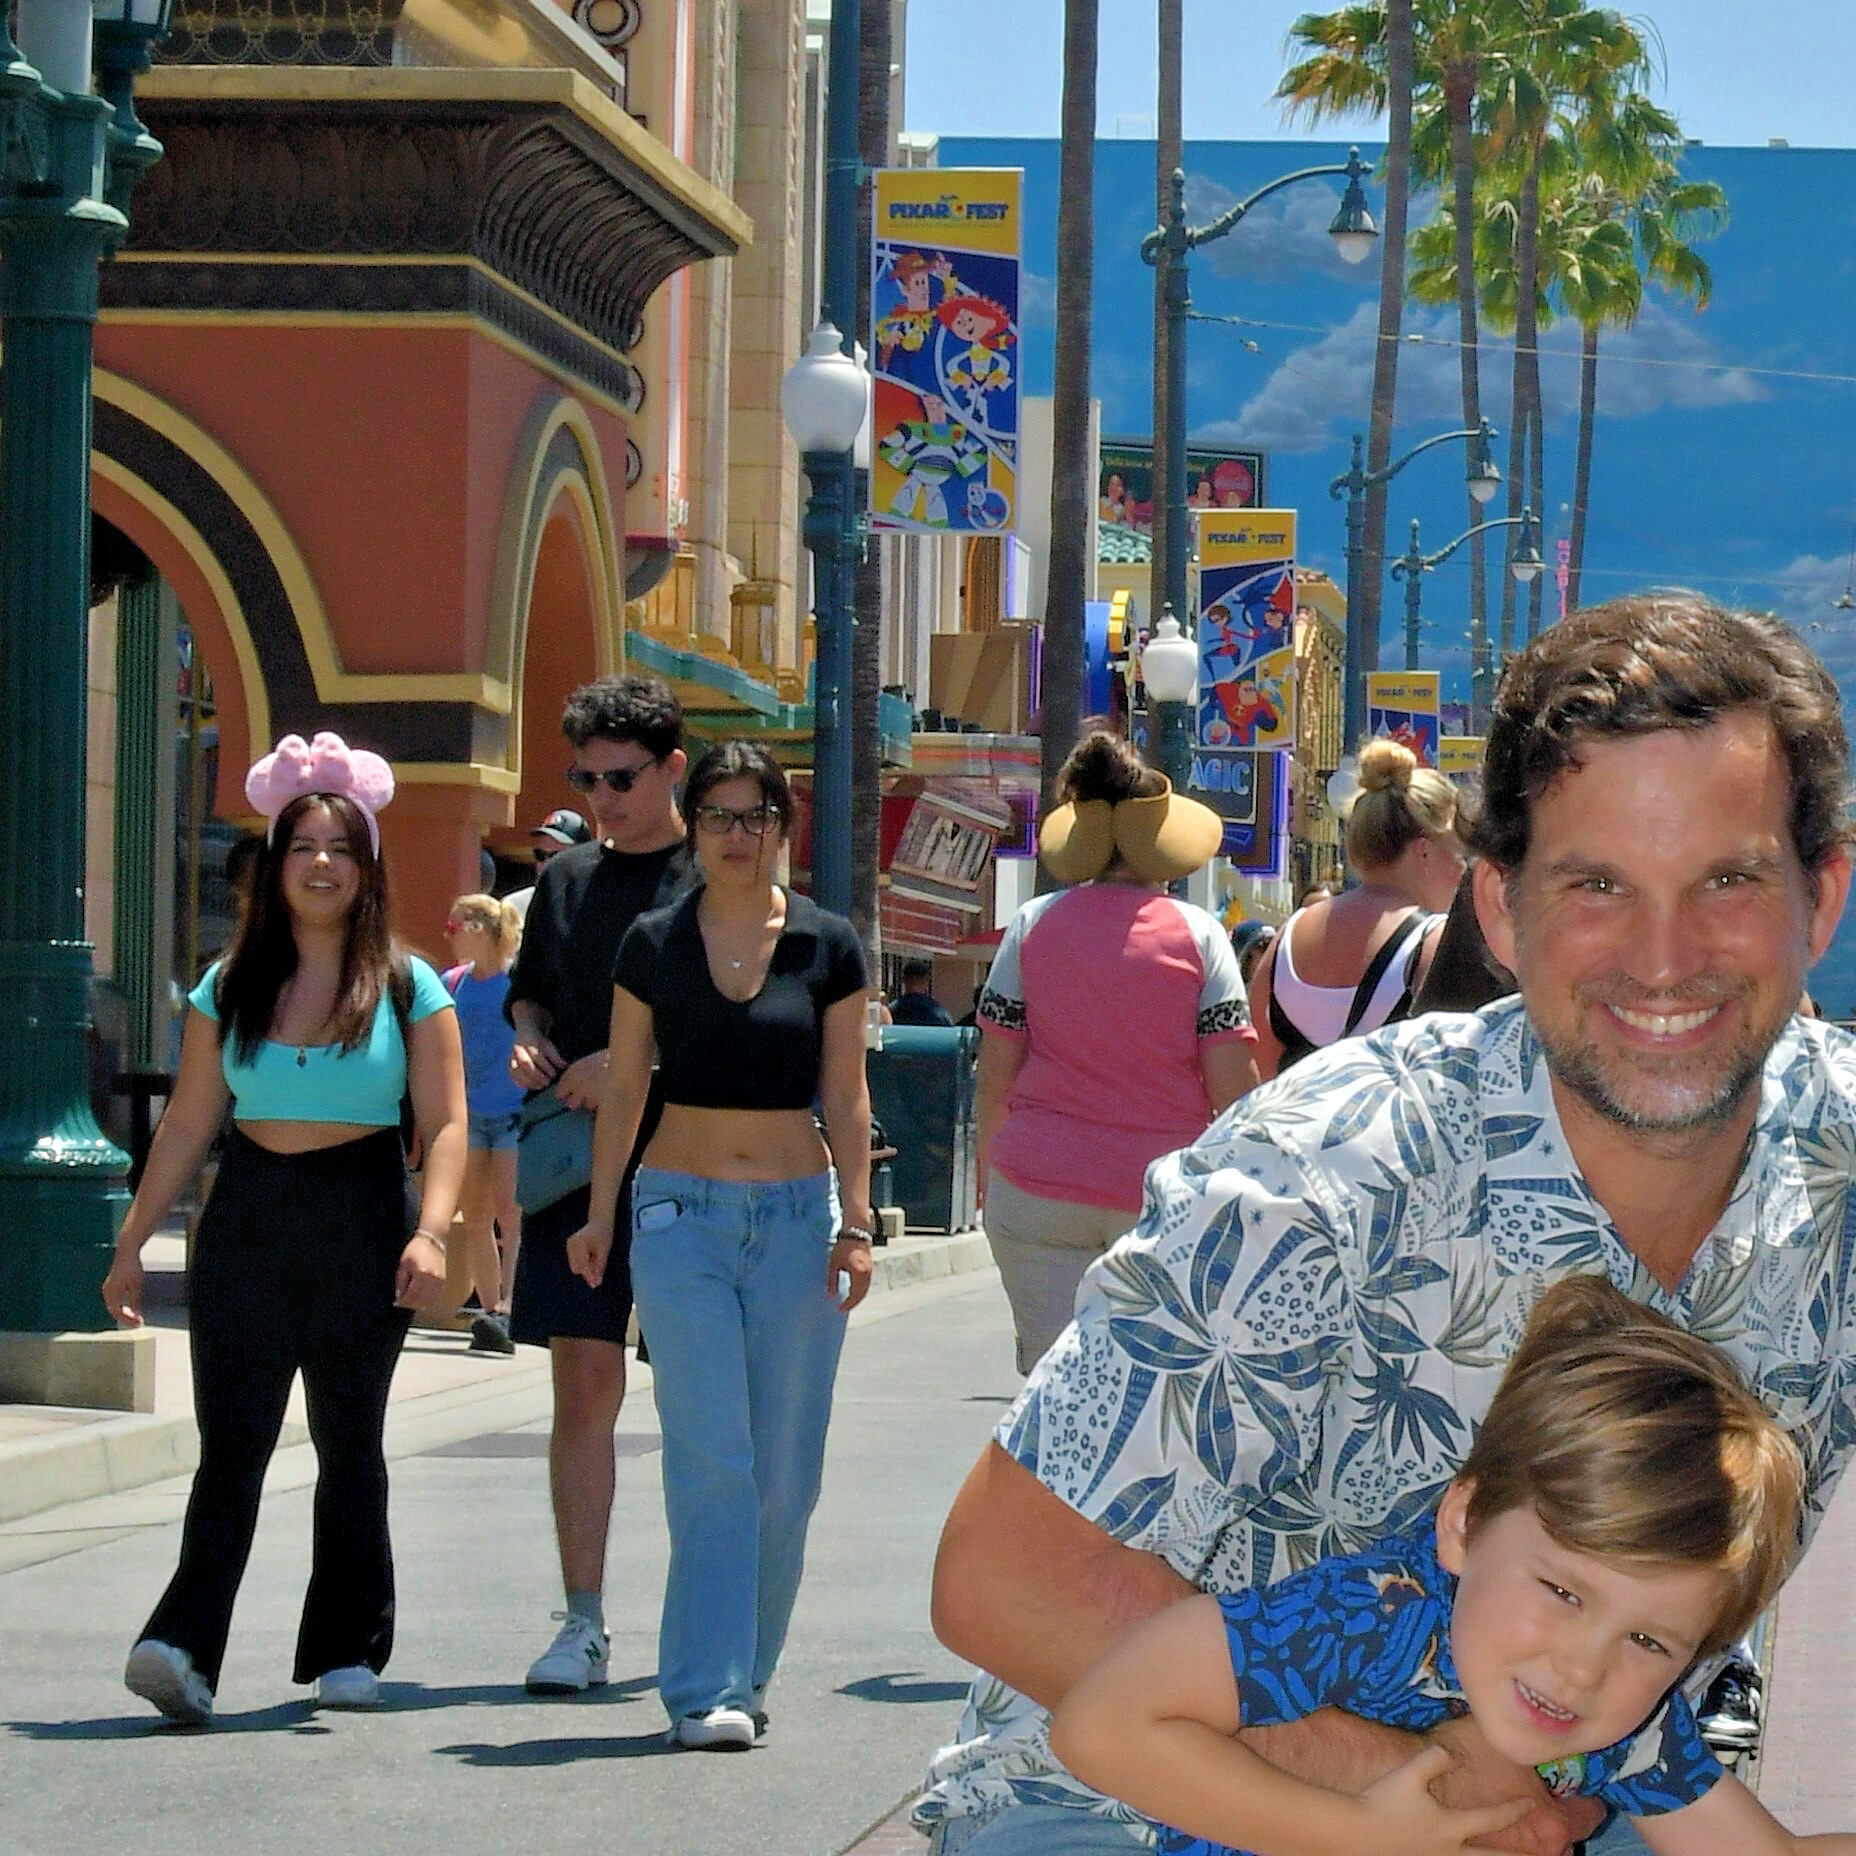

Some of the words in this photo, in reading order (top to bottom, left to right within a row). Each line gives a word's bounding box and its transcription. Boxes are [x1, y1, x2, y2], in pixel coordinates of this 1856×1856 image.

[889, 202, 950, 219] PIXAR
[965, 203, 1009, 220] FEST
[1187, 755, 1251, 795] AGIC
